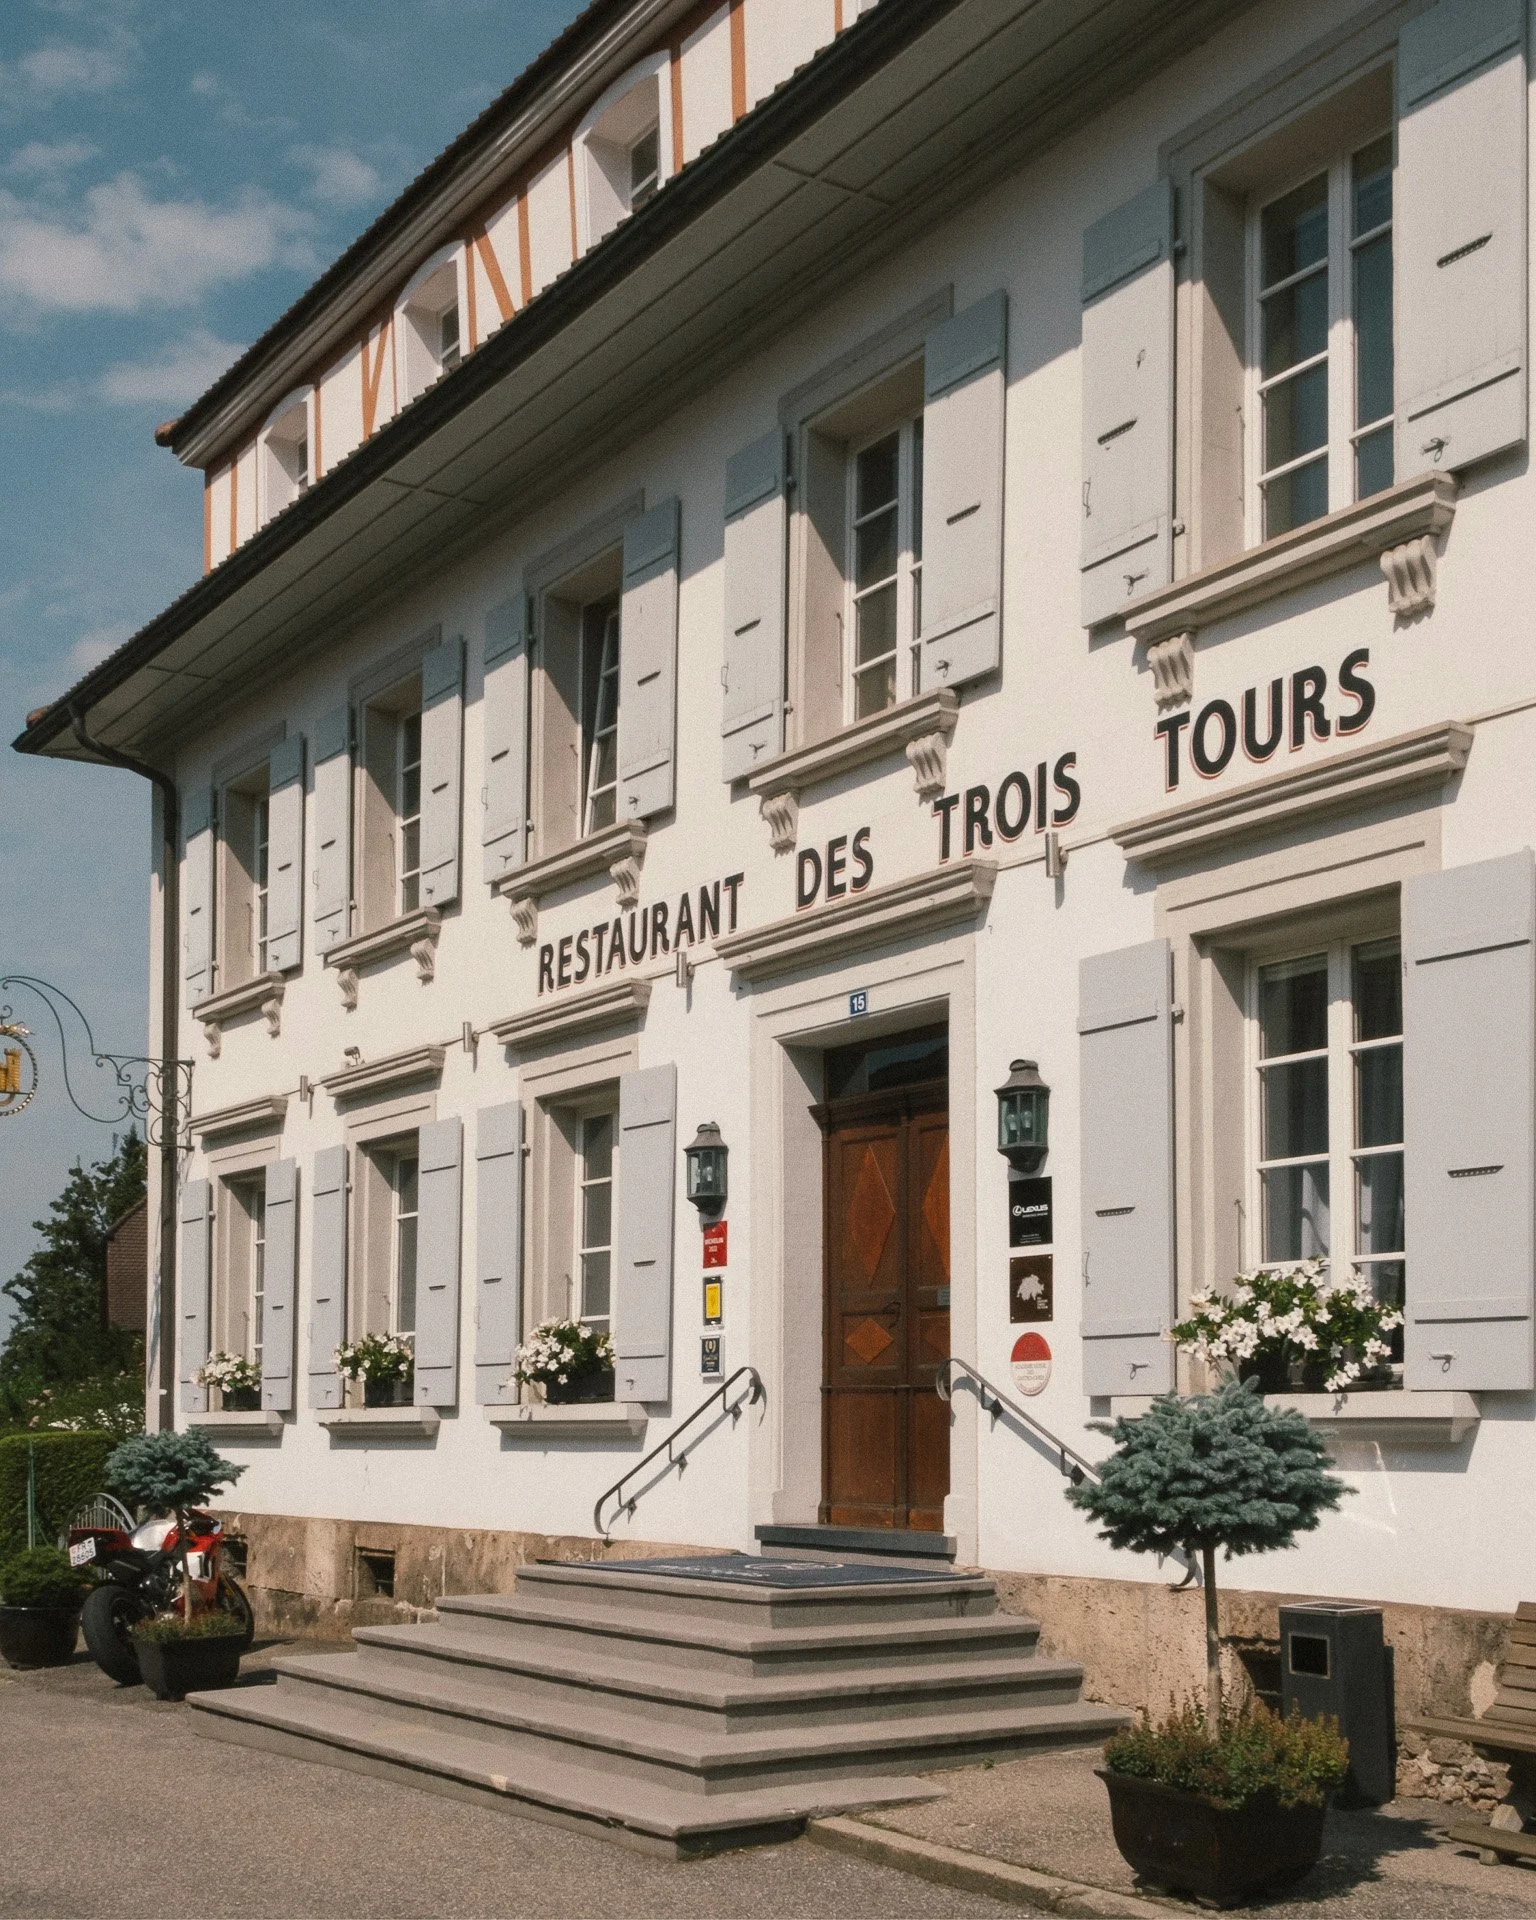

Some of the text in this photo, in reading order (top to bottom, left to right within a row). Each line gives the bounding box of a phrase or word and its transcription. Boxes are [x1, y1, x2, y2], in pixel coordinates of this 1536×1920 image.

[539, 648, 1376, 994] RESTAURANT DES TROIS TOURS
[852, 995, 865, 1011] 15
[1022, 1204, 1048, 1213] LEXUS
